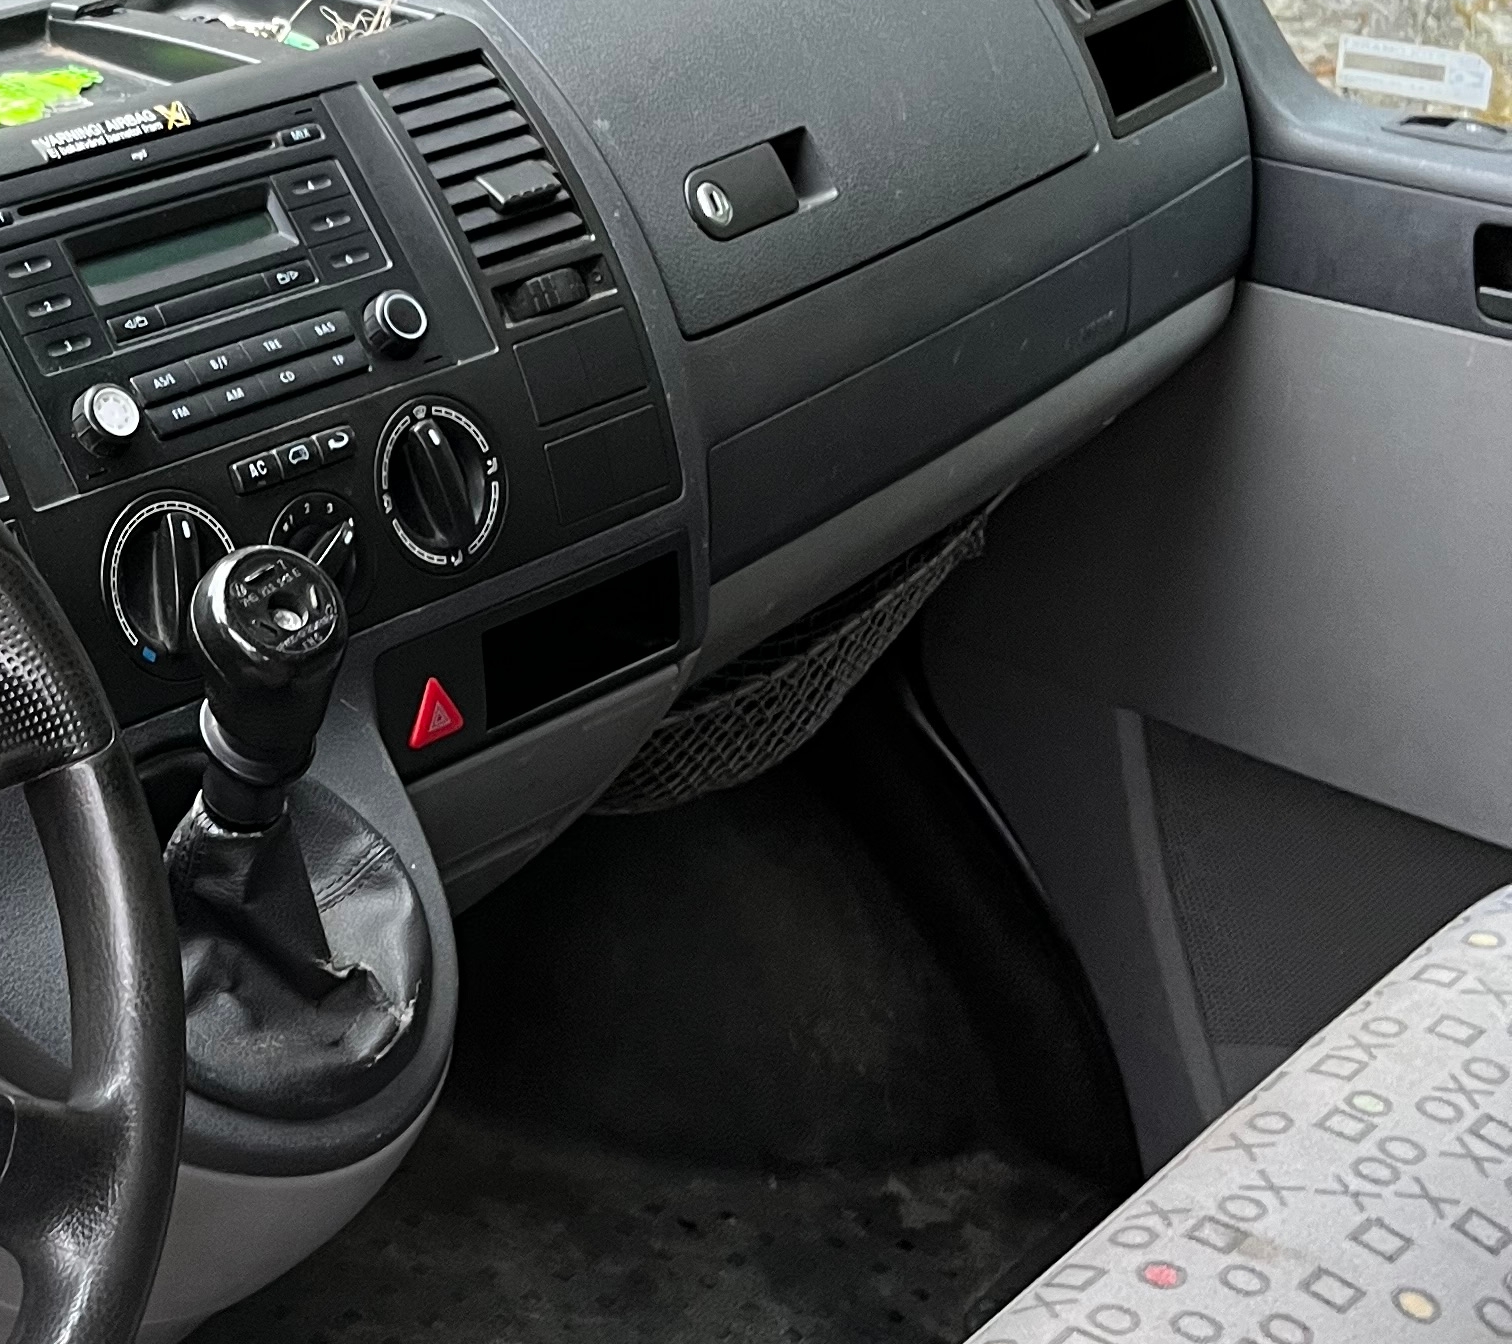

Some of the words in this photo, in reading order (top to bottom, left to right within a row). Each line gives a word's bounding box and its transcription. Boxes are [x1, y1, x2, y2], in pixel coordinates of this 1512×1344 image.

[105, 109, 158, 132] AIRBAG
[262, 338, 283, 353] TRE
[314, 321, 336, 337] BAS
[171, 405, 191, 421] FM
[225, 387, 245, 403] AM
[279, 369, 296, 385] CD
[248, 459, 268, 479] AC
